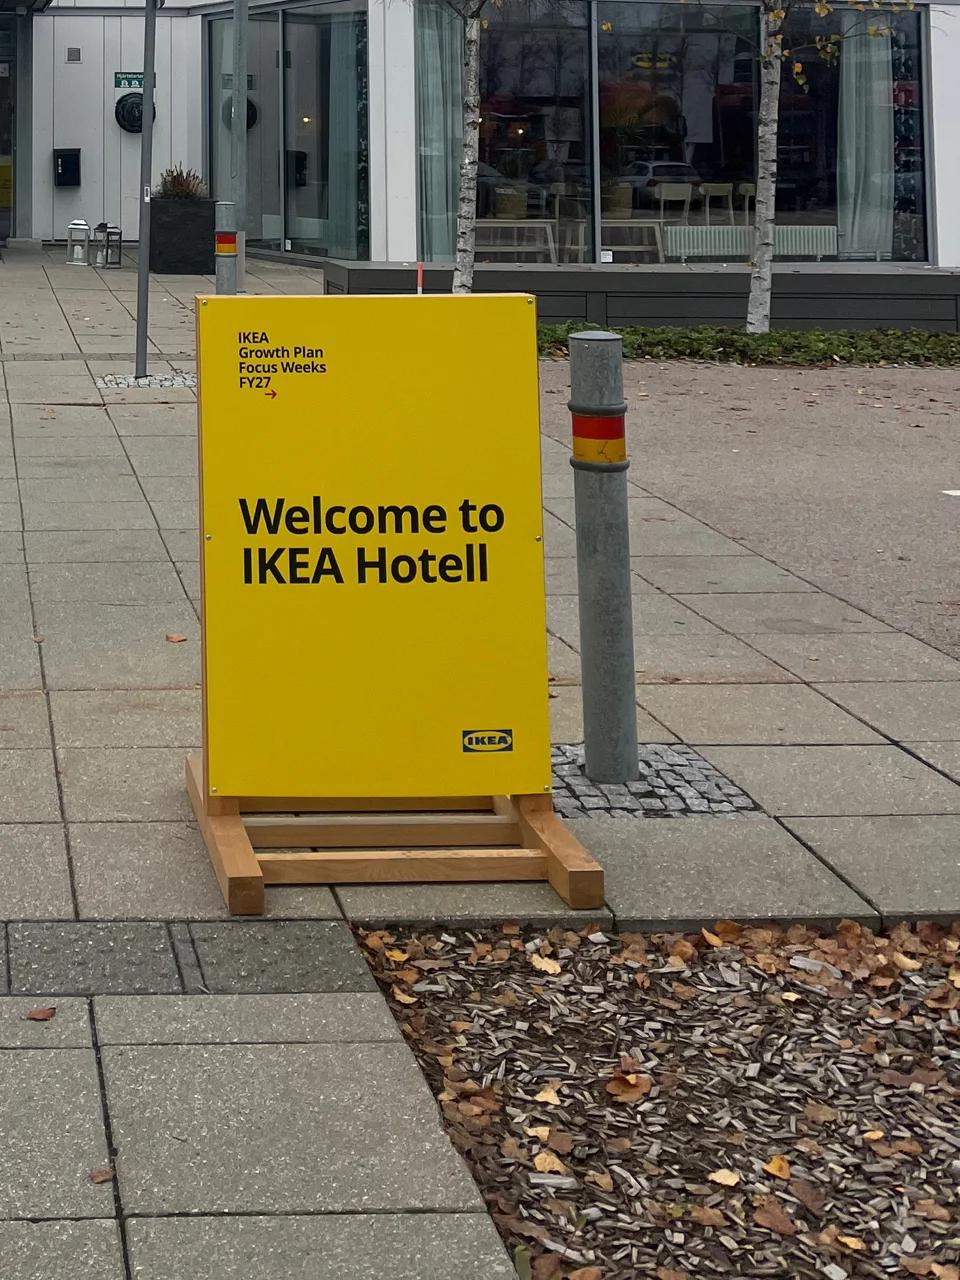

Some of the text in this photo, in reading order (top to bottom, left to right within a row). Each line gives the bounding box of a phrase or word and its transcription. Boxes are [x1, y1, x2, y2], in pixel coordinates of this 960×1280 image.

[238, 331, 270, 344] IKEA
[239, 346, 324, 359] Growth Plan
[239, 361, 327, 374] Focus Weeks
[239, 376, 272, 389] FY27
[239, 495, 505, 535] Welcome to
[243, 543, 489, 585] IKEA Hotell
[467, 735, 509, 746] IKEA
